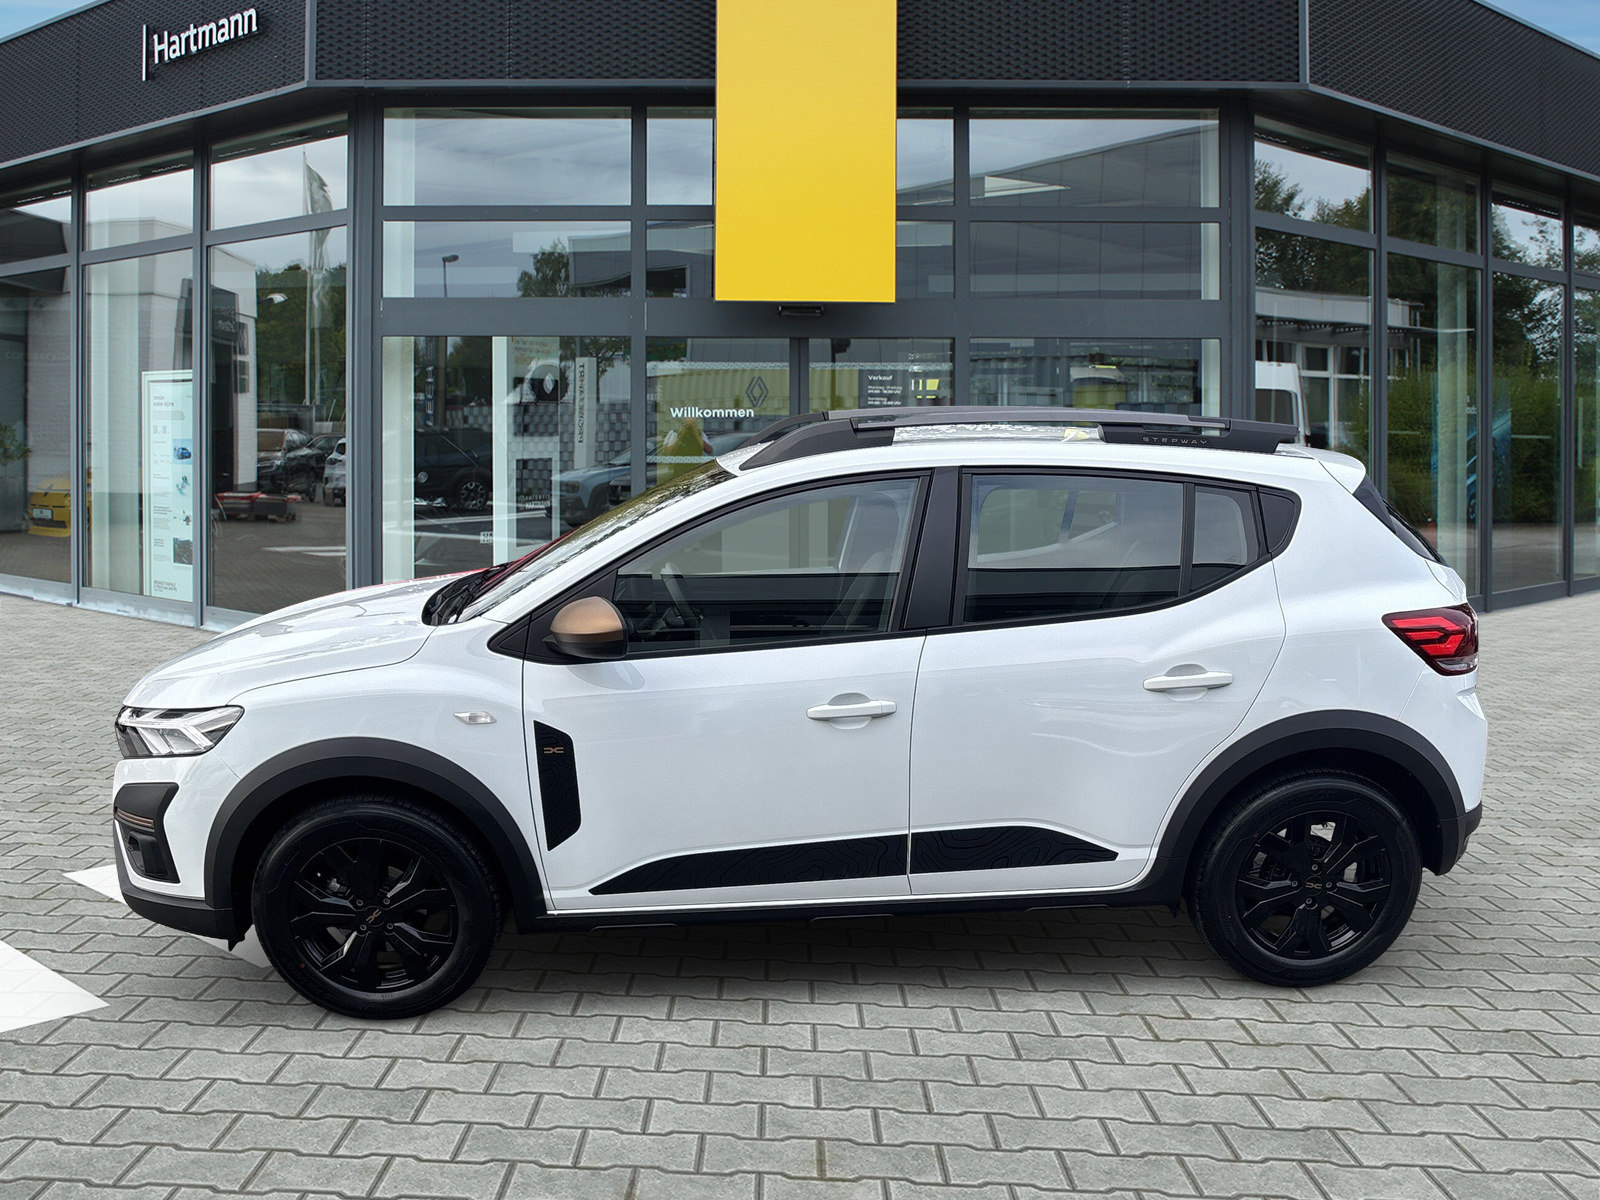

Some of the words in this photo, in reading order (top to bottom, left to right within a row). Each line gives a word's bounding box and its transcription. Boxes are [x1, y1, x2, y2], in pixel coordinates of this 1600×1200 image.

[153, 8, 258, 64] Hartmann
[670, 407, 755, 418] Willkommen
[1142, 437, 1207, 445] STEPWAY
